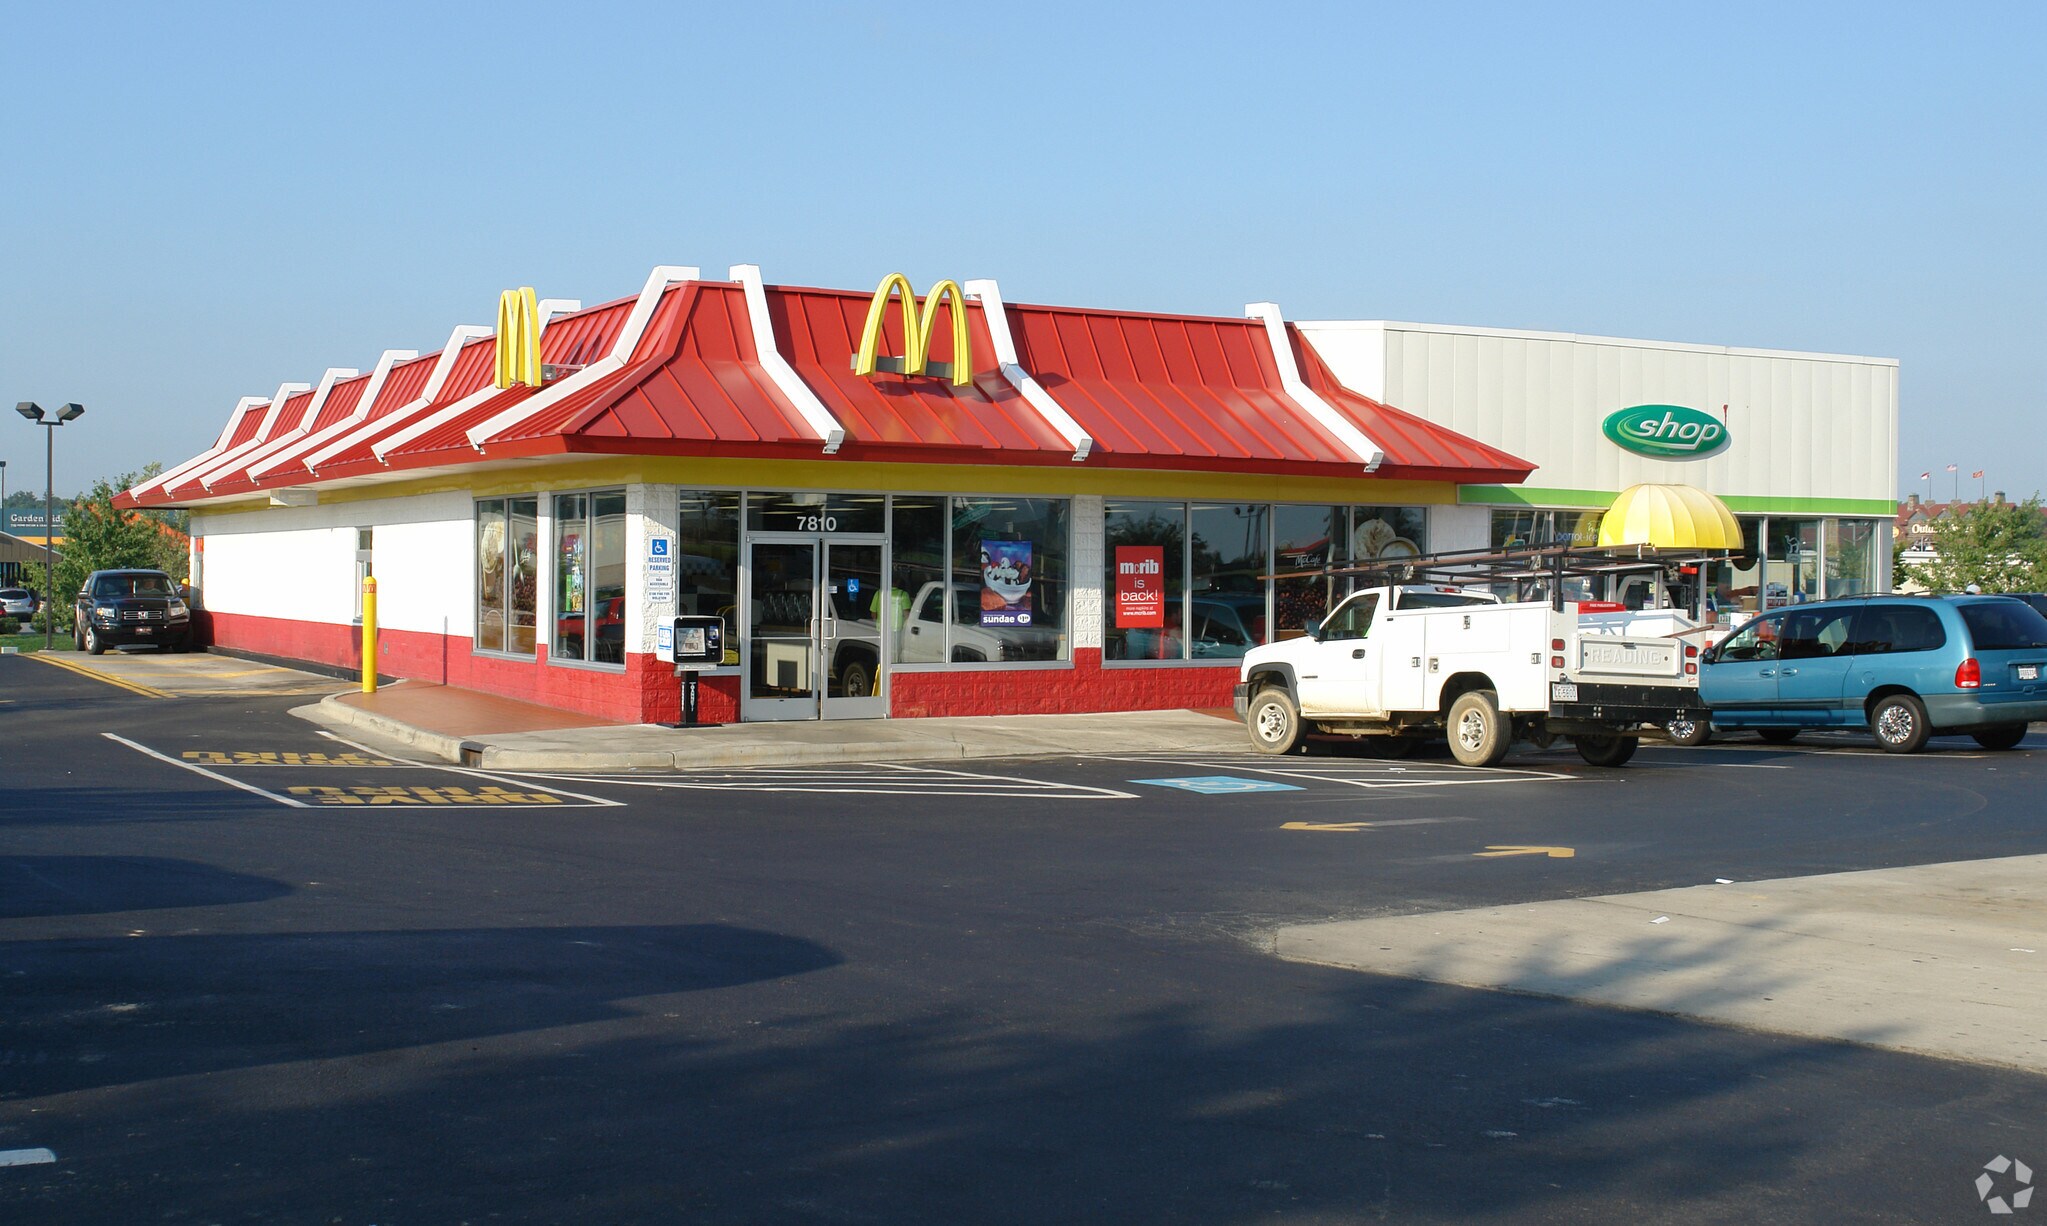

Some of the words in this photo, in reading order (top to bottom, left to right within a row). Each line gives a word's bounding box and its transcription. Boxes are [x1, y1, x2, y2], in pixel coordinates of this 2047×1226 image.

[1639, 411, 1720, 450] shop
[10, 513, 44, 522] Garden
[796, 516, 837, 531] 7810
[1120, 559, 1159, 574] mcrib
[1134, 577, 1145, 589] is
[1121, 589, 1158, 601] back!
[983, 615, 1015, 623] sundae
[1590, 648, 1662, 665] READING
[287, 786, 523, 796] THRU
